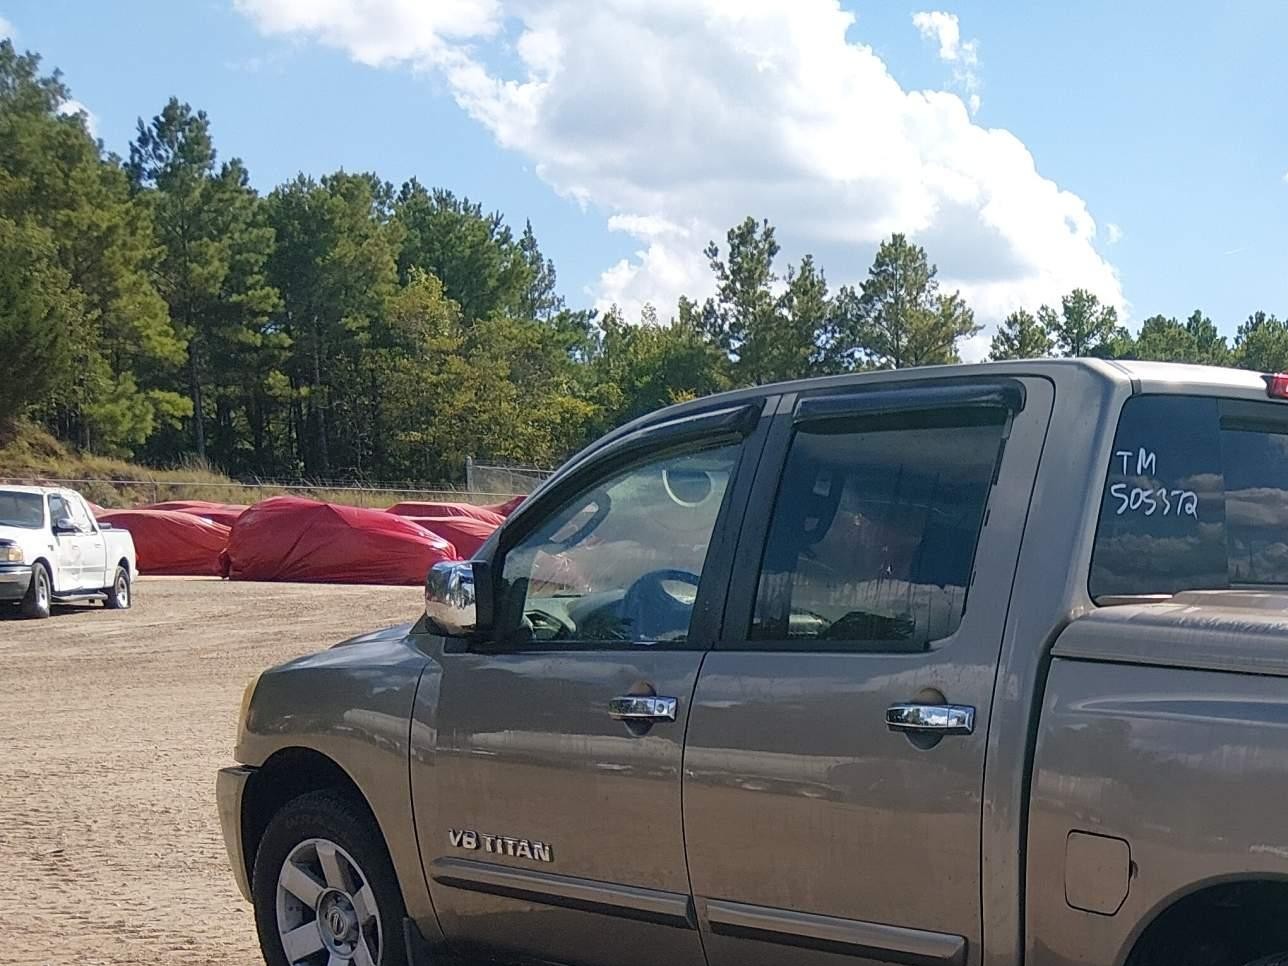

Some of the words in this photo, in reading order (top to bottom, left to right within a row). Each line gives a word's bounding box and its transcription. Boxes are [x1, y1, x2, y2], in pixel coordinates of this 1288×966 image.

[1116, 447, 1156, 476] TM
[449, 828, 477, 850] V8
[482, 833, 551, 862] TITAN
